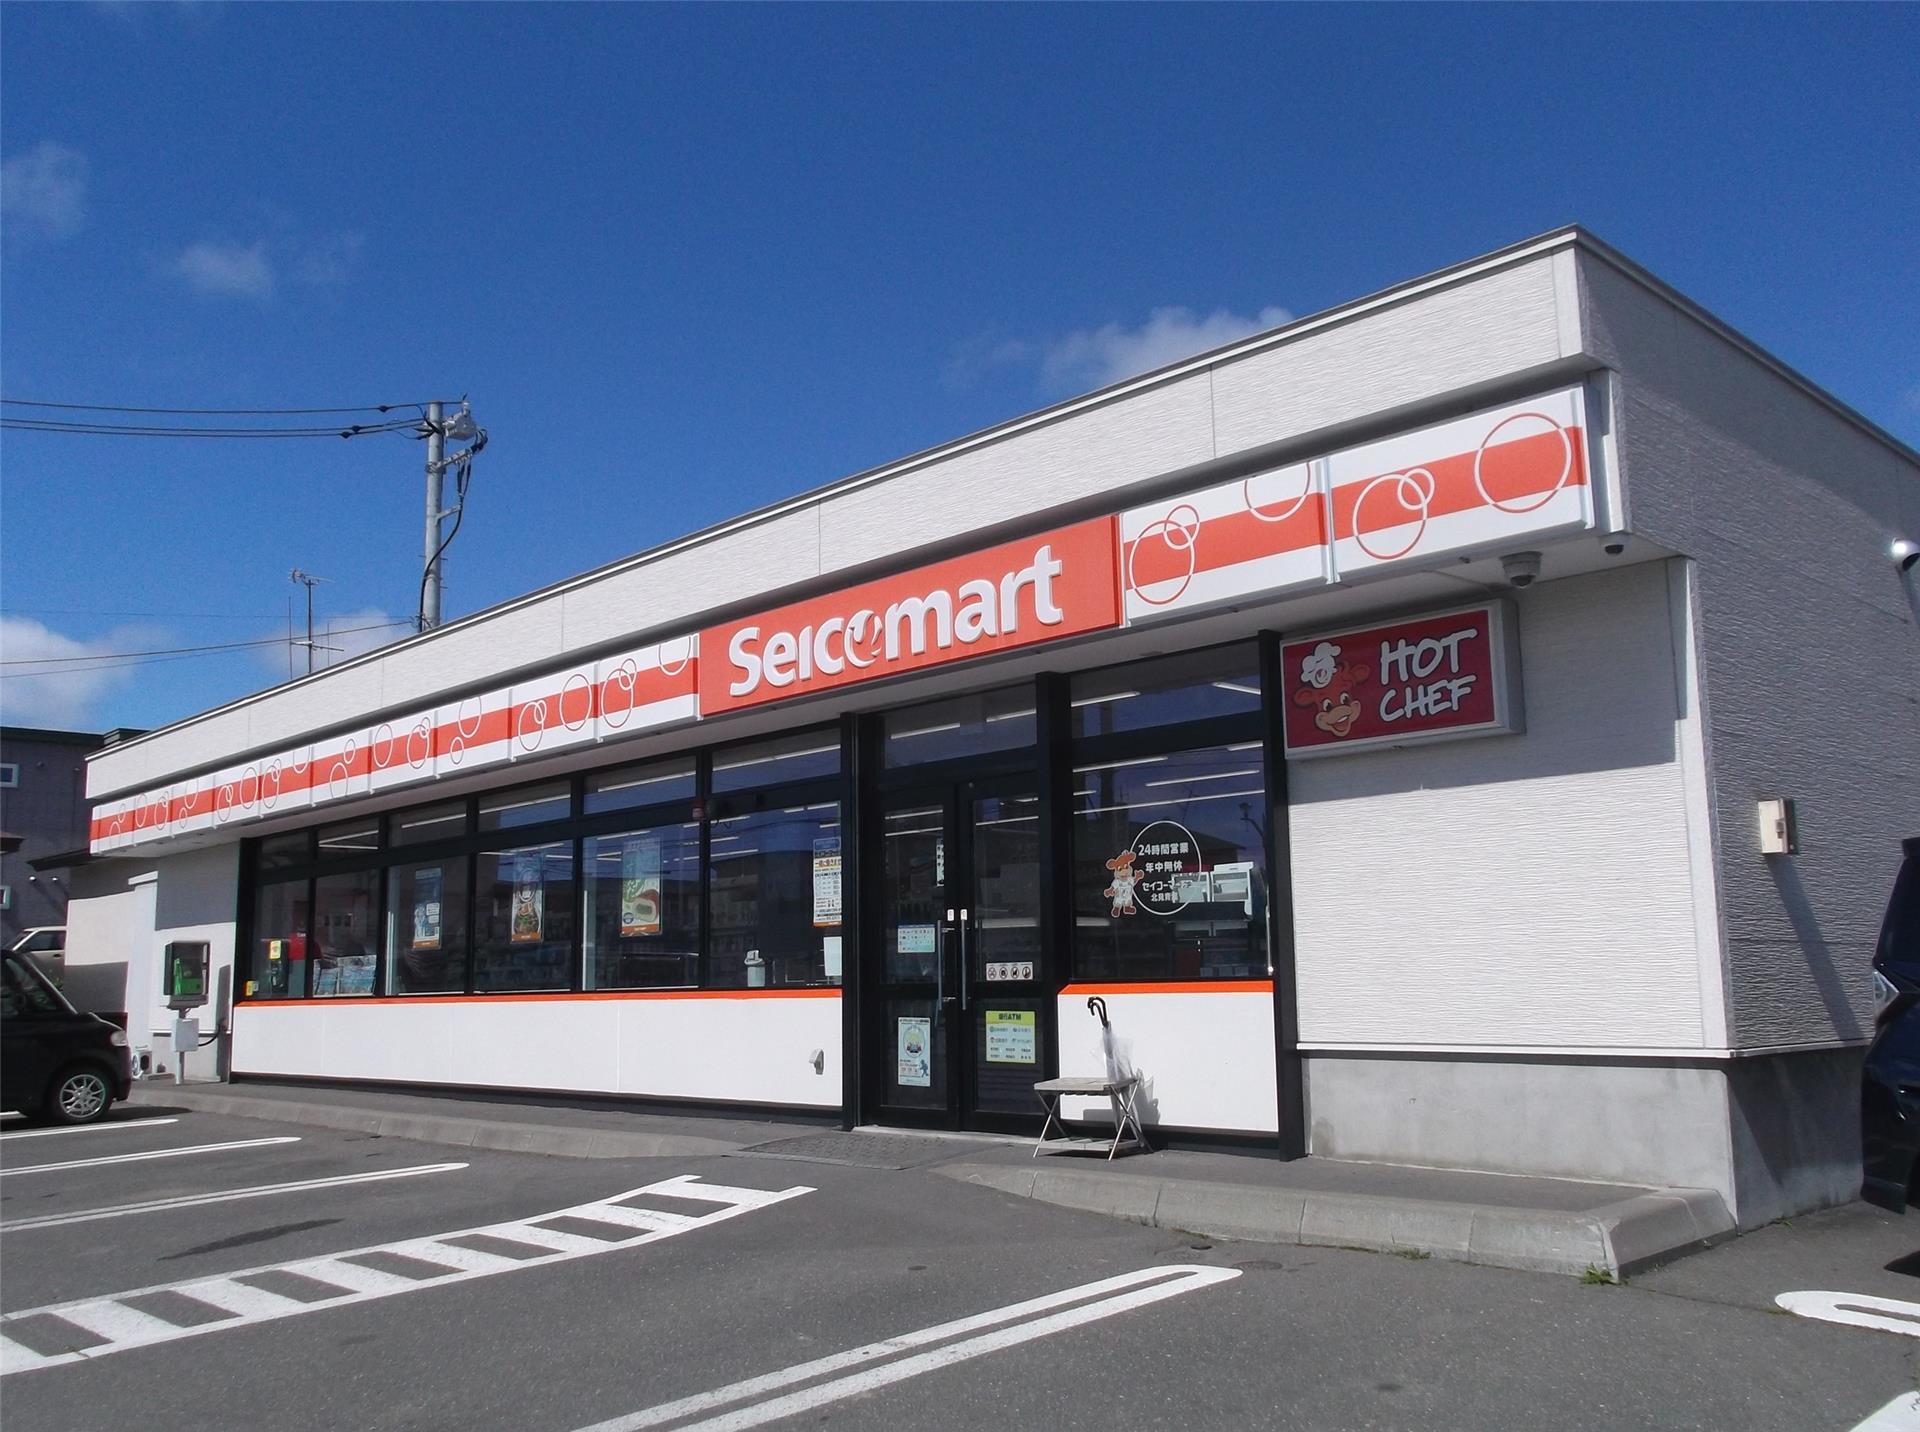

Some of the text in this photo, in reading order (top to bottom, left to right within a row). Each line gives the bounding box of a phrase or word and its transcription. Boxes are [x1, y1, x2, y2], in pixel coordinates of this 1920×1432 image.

[729, 545, 1064, 697] Seicomart
[1380, 629, 1478, 686] HOT
[1379, 675, 1477, 722] CHEF
[1138, 842, 1189, 856] 24時間営業
[1145, 860, 1183, 873] 年中無休
